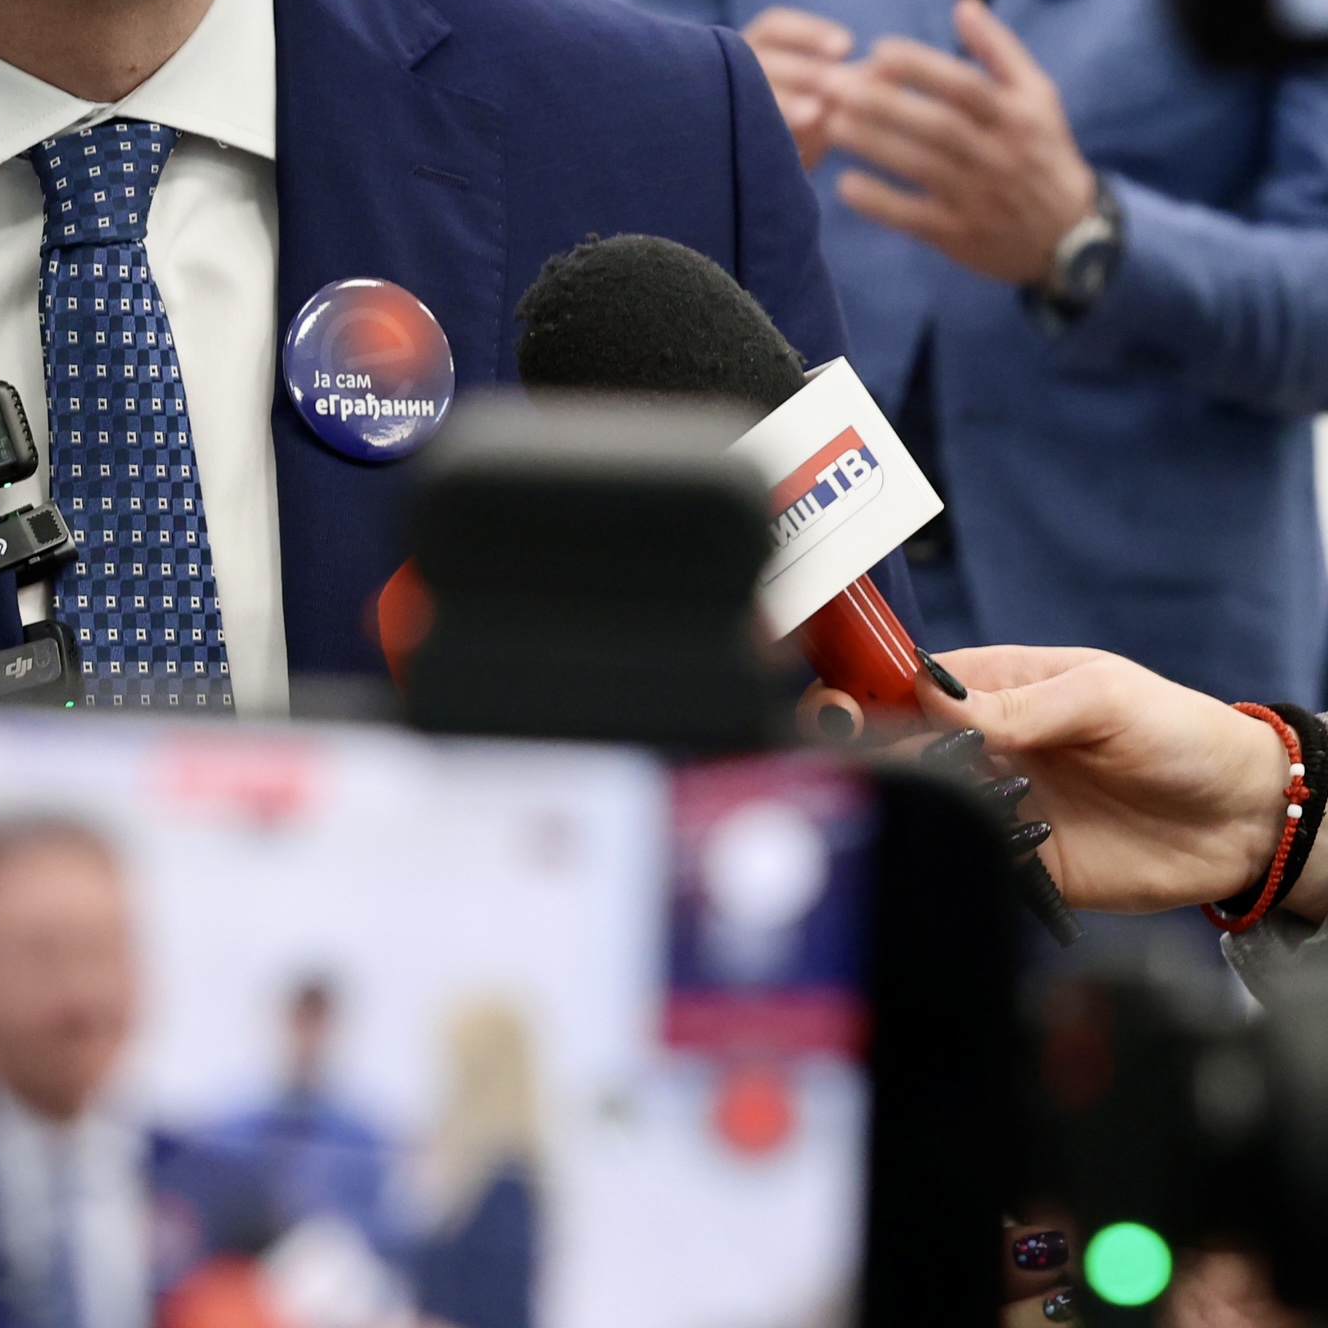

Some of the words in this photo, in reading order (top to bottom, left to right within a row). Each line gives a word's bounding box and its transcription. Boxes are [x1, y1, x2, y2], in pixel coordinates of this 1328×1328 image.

[313, 370, 331, 388] Ја
[335, 373, 372, 389] сам
[315, 393, 435, 421] еГрађанин
[769, 491, 826, 549] ИШ
[815, 448, 873, 502] ТВ
